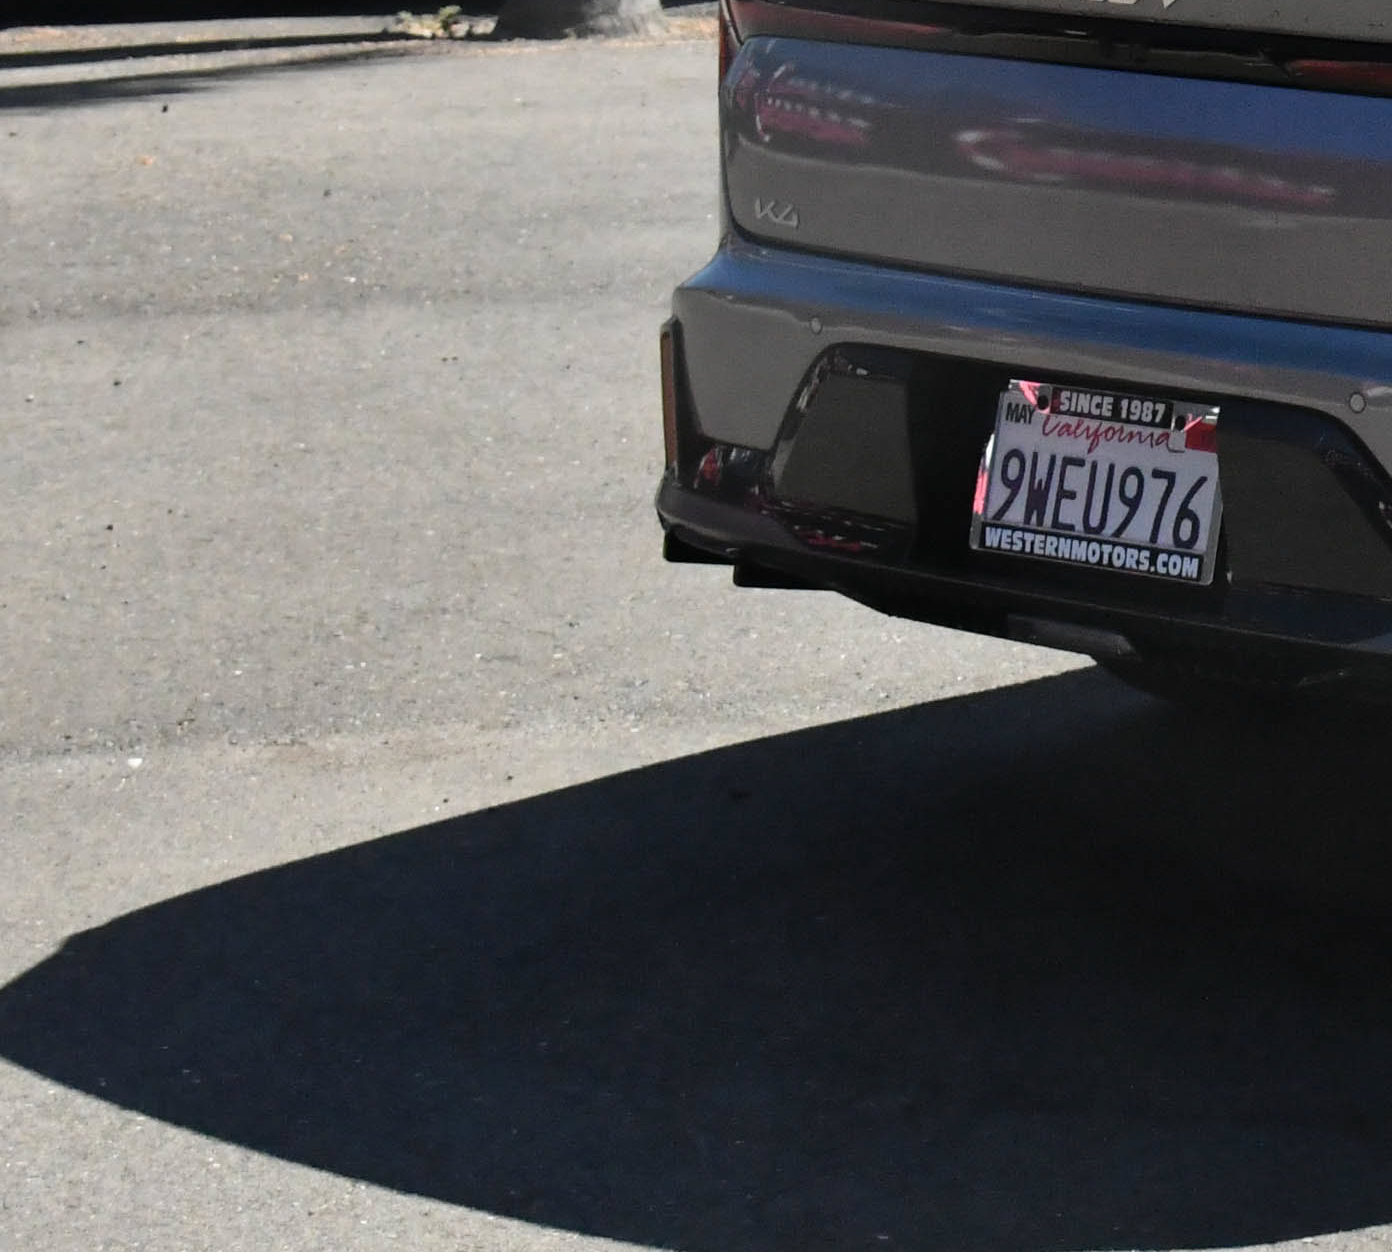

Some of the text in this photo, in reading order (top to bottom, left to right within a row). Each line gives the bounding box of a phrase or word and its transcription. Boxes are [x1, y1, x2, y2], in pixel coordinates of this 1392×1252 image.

[755, 198, 798, 228] K4
[1005, 401, 1037, 425] MAY
[1060, 390, 1166, 423] SINCE 1987
[1041, 416, 1171, 454] California
[992, 448, 1209, 549] 9WEU976
[985, 526, 1199, 580] WESTERNMOTORS.COM
